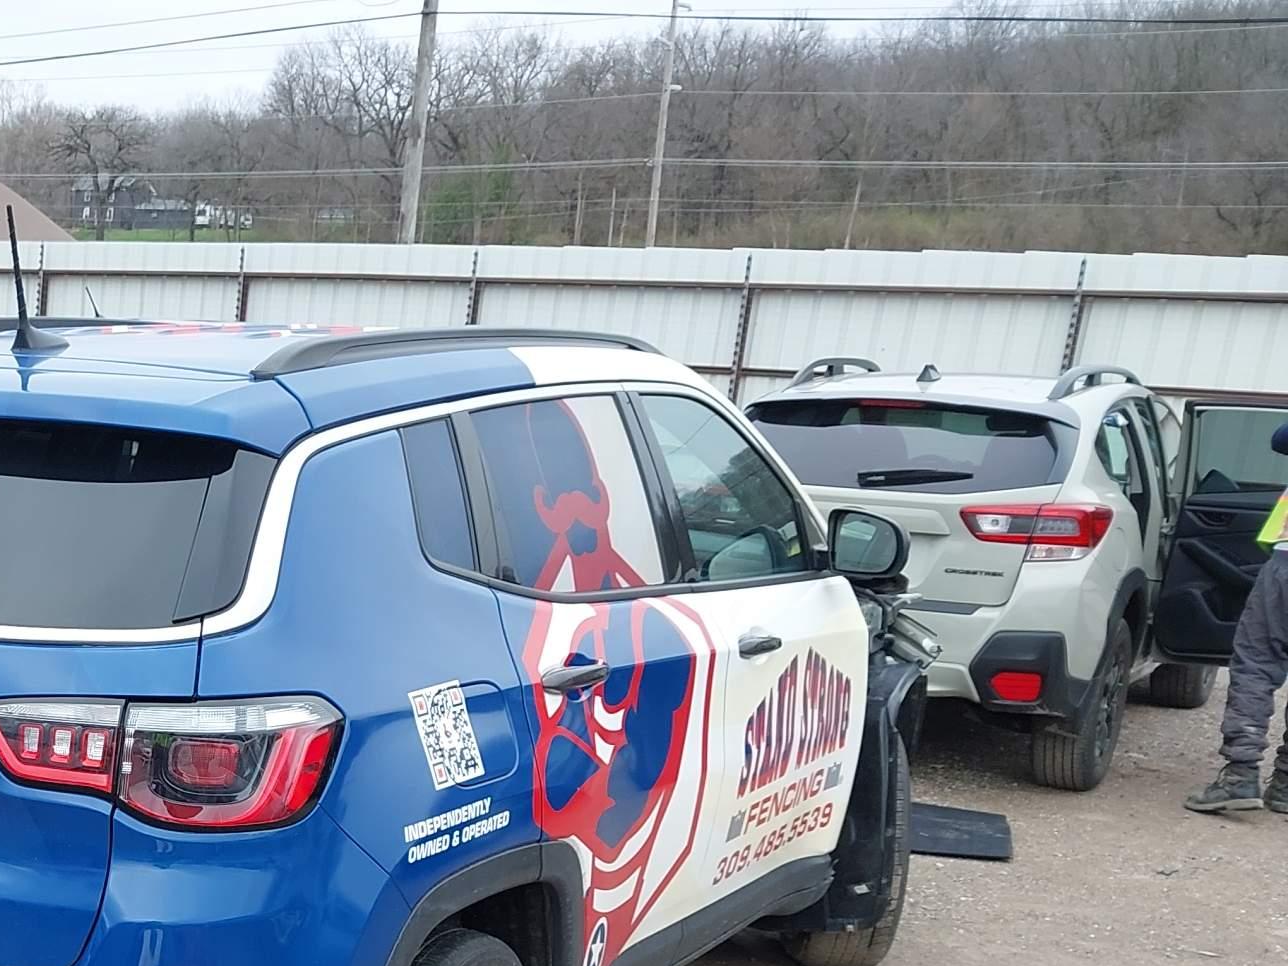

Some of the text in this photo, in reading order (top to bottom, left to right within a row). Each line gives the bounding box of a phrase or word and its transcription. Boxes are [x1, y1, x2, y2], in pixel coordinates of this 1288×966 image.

[736, 646, 851, 799] STAND STRONG
[404, 797, 491, 843] INDEPENDENTLY
[743, 768, 825, 835] FENCING
[408, 810, 510, 864] OWNED & OPERATED
[712, 802, 833, 886] 309.485.5539
